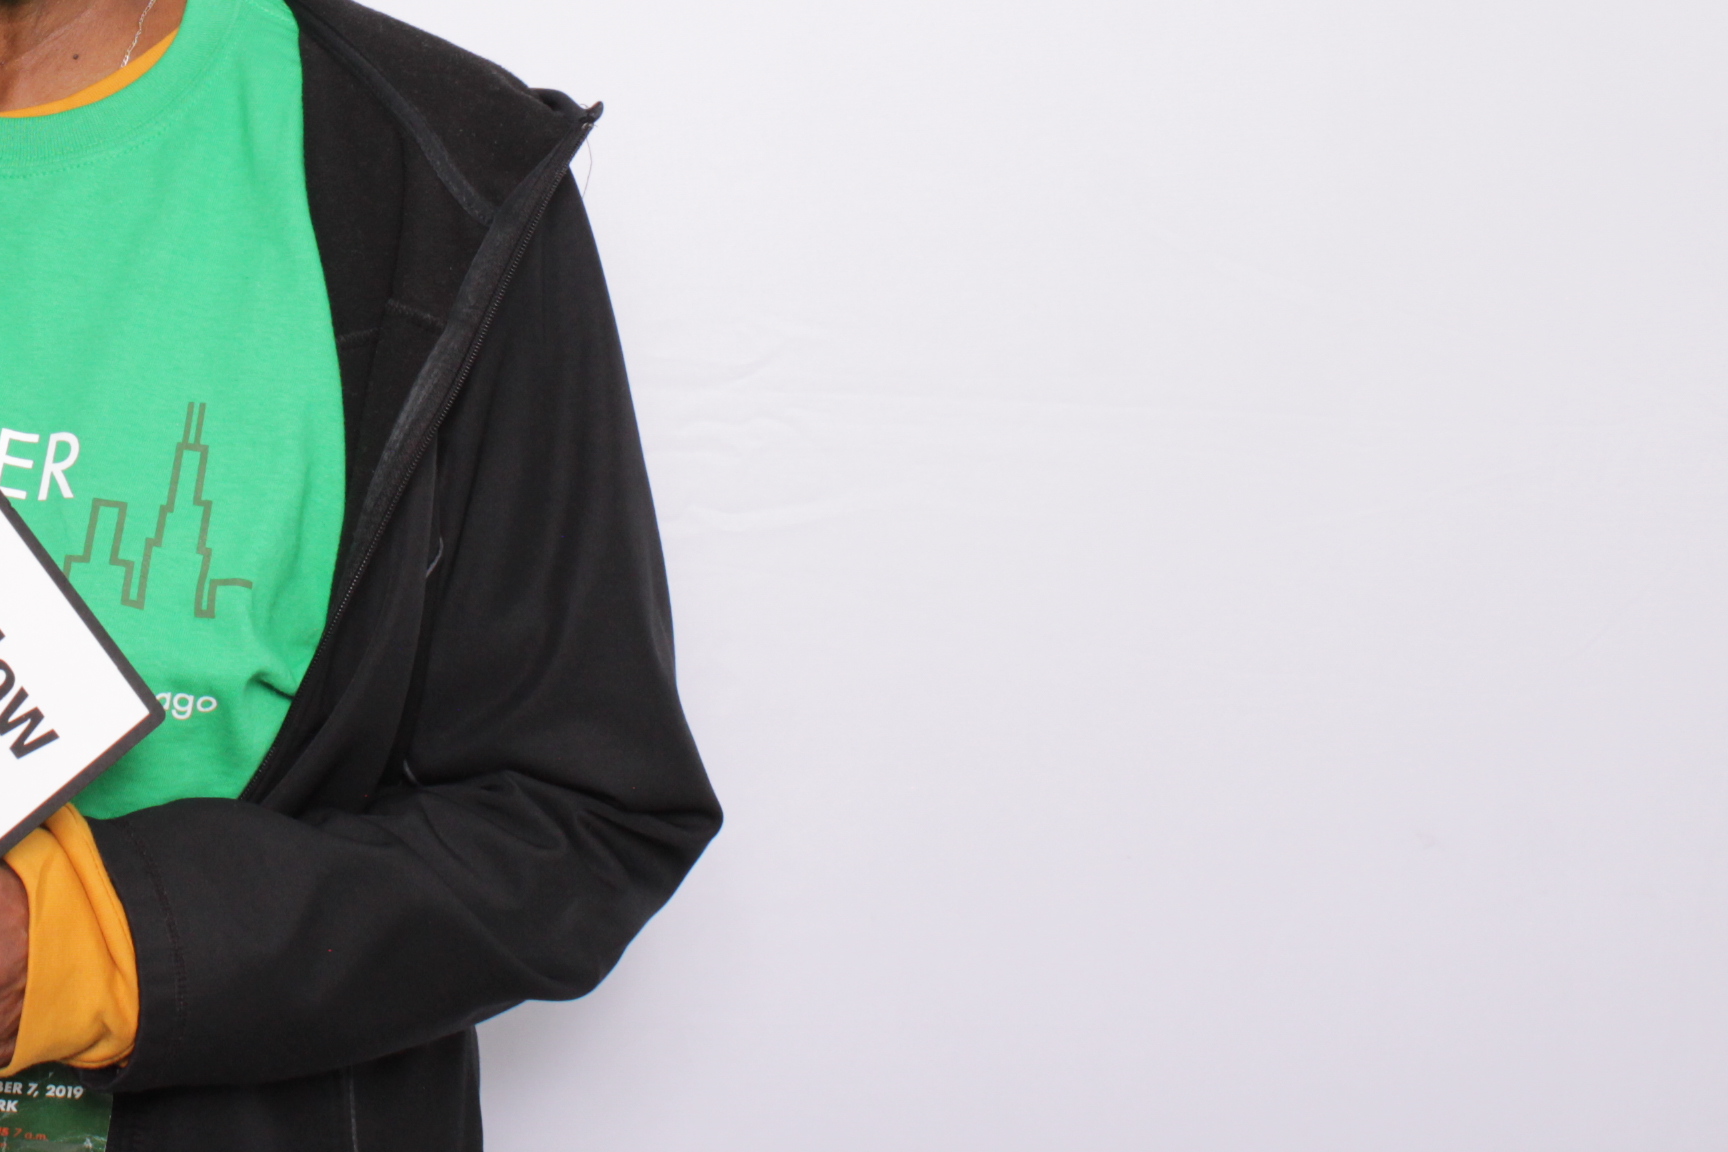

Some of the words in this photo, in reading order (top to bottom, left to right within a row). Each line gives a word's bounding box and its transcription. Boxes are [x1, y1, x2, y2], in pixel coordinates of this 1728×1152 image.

[26, 1083, 39, 1097] 7,
[46, 1084, 83, 1099] 2019
[13, 1128, 22, 1137] 7
